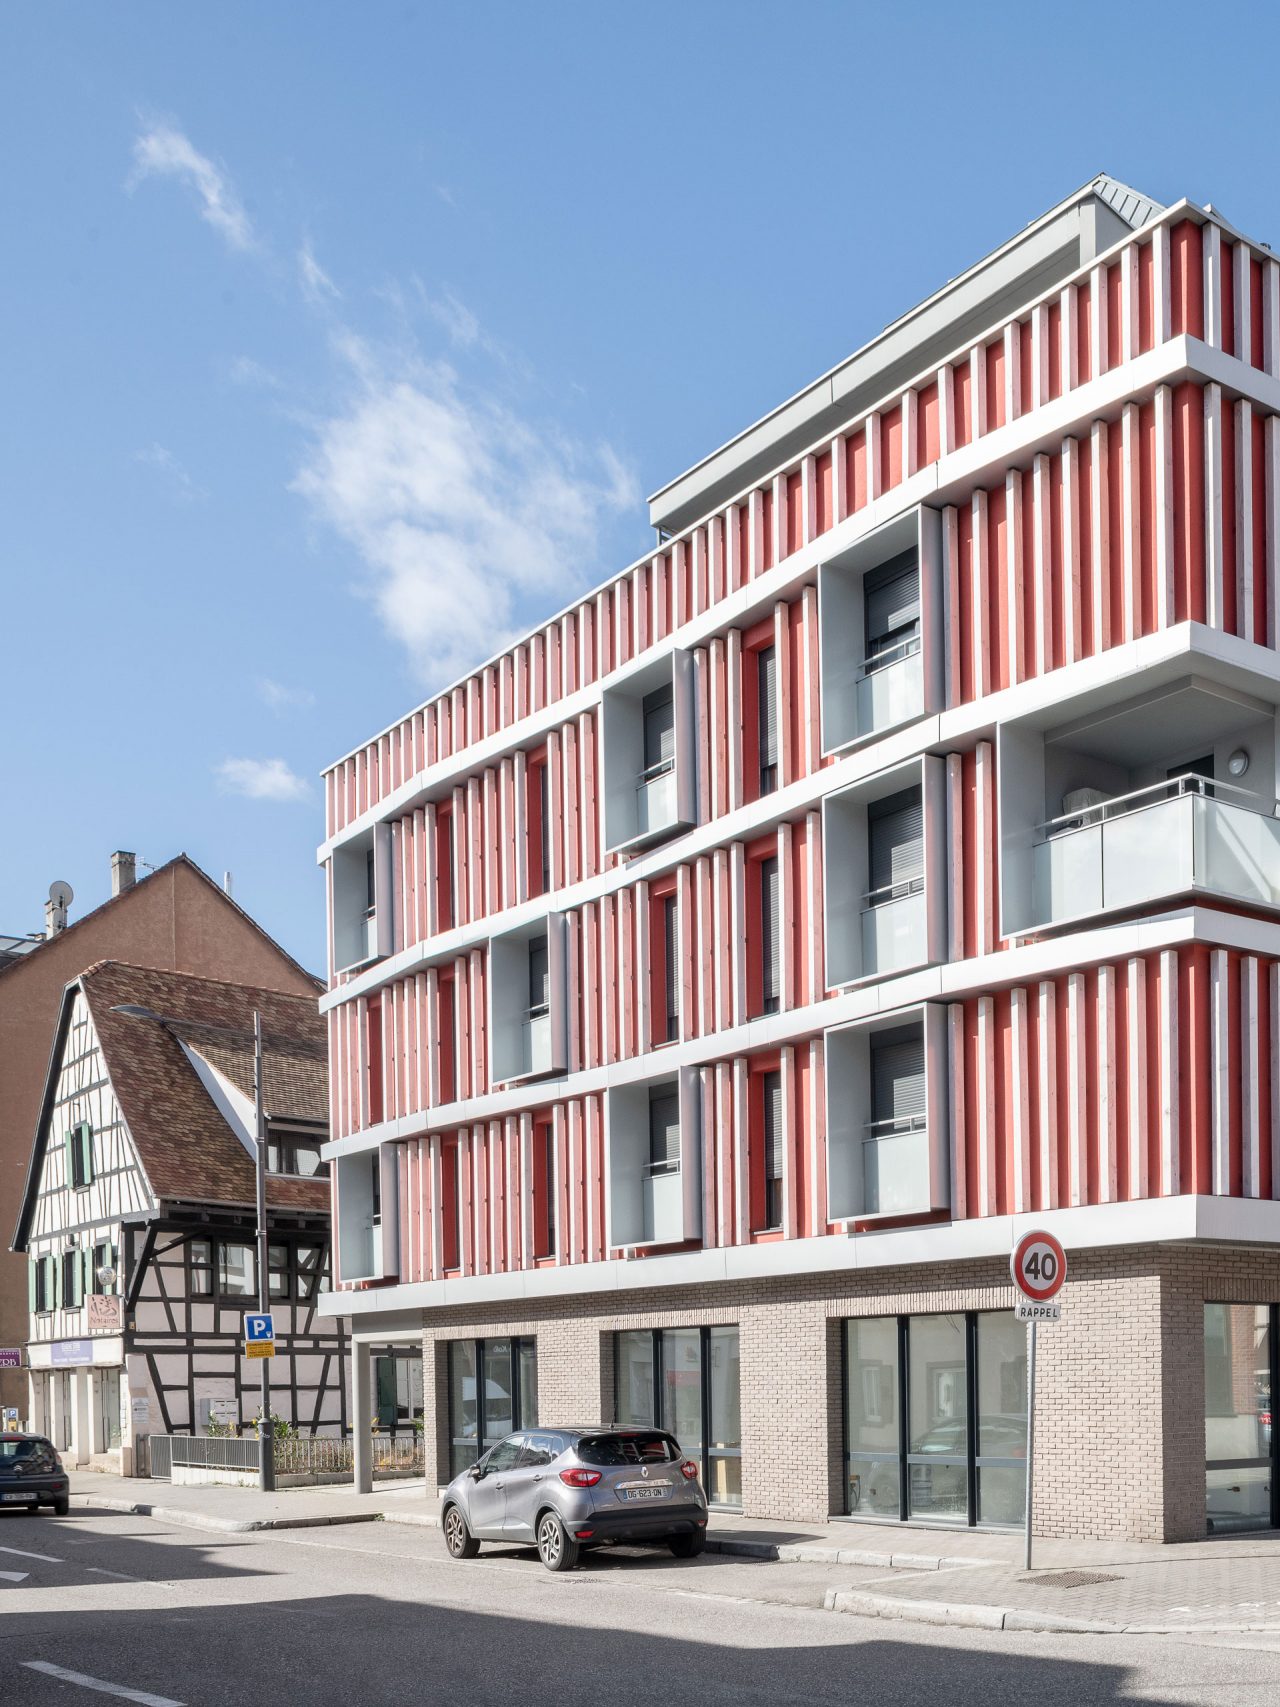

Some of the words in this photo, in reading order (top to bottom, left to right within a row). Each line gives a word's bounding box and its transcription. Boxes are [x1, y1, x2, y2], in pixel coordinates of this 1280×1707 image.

[1025, 1252, 1056, 1280] 40
[1020, 1307, 1058, 1318] RAPPEL
[90, 1316, 118, 1324] Notaires
[253, 1319, 266, 1336] P
